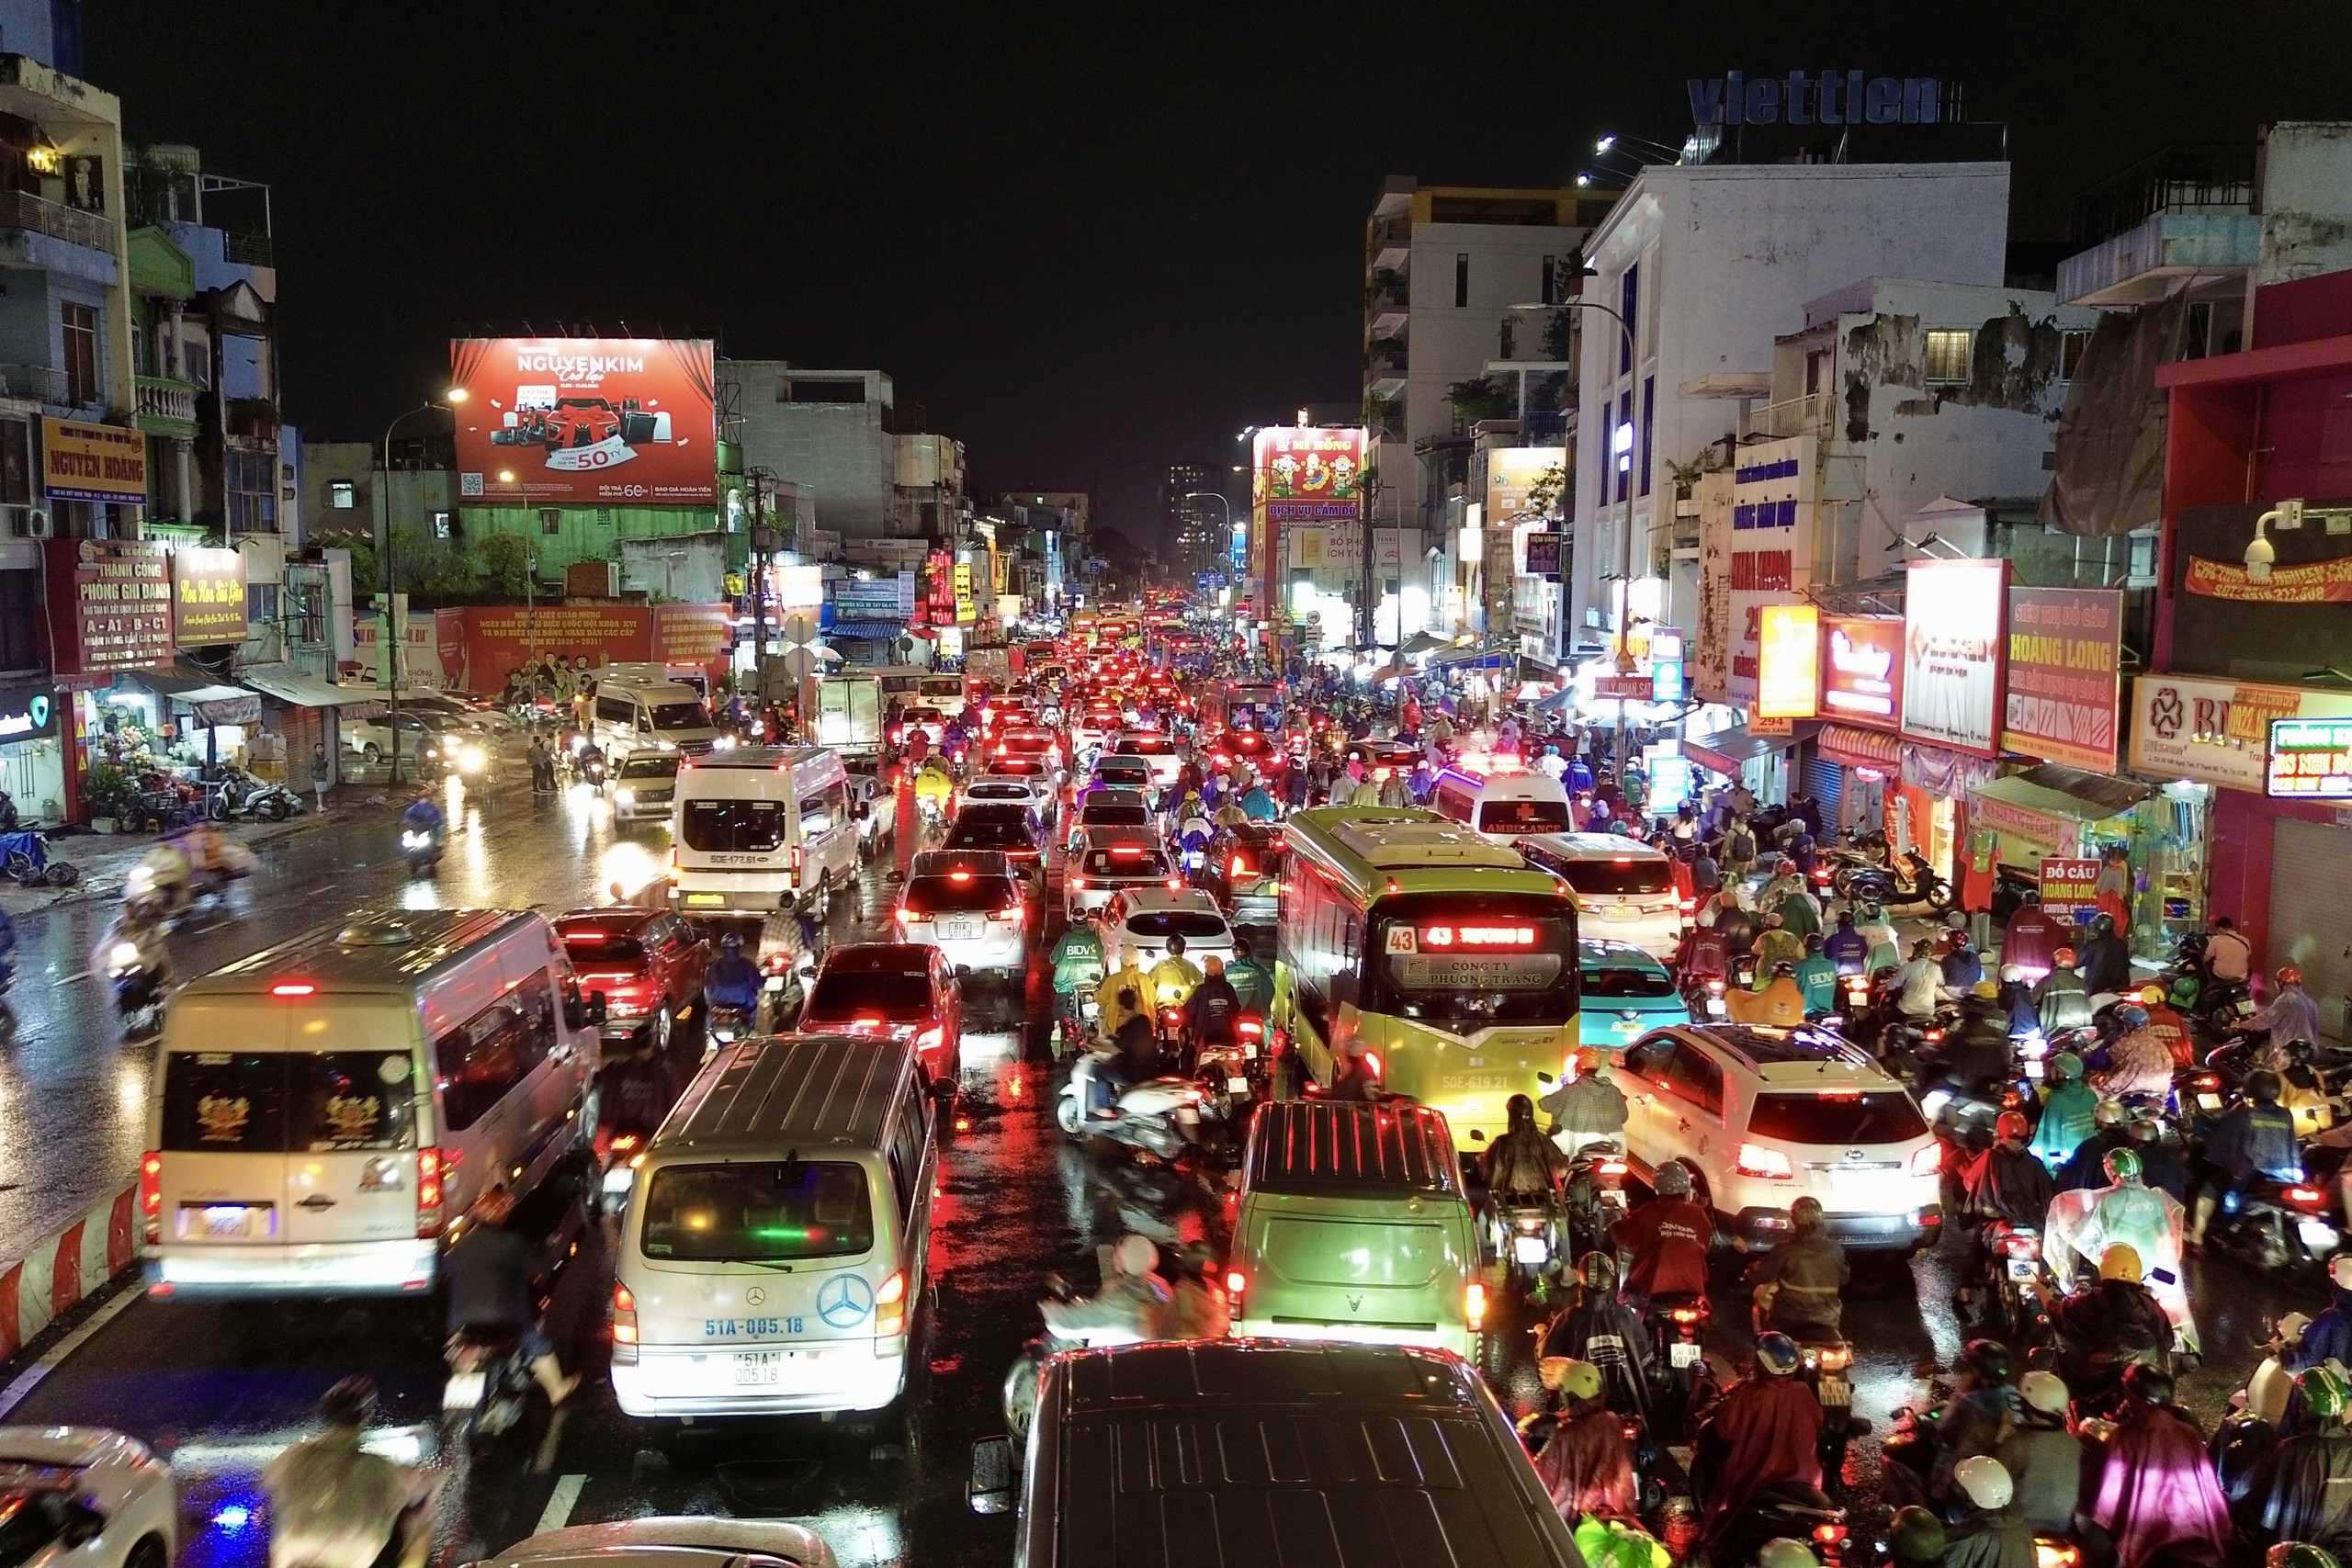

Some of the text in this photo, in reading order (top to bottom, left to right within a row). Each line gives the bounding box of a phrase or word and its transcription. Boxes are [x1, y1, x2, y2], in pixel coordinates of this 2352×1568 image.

[517, 355, 643, 373] NGUYENKIM
[578, 450, 608, 468] 50
[624, 484, 642, 497] 60
[1271, 505, 1295, 517] DỊCH
[1298, 505, 1311, 517] VỤ
[100, 560, 162, 577] THÀNH CÔNG
[80, 579, 171, 601] PHÒNG GHI DANH
[86, 616, 165, 633] A A1 B C1
[931, 608, 953, 625] TÔM
[2010, 630, 2062, 666] HOÀNG
[2065, 638, 2111, 672] LONG
[1618, 682, 1637, 695] QUAN
[1639, 679, 1652, 695] SÁT
[1758, 717, 1784, 726] 294
[1487, 823, 1562, 834] AMBULANCE
[2045, 862, 2096, 879] ĐỒ CÂU
[2042, 881, 2073, 898] HOÀNG
[1390, 931, 1413, 951] 43
[1427, 927, 1453, 944] 43
[1067, 945, 1091, 955] BIDV
[1451, 960, 1511, 971] CÔNG TY
[1227, 972, 1250, 980] GREEN
[1429, 973, 1542, 984] PHƯƠNG TRANG
[1442, 1076, 1509, 1089] 50E-619.21
[706, 1317, 803, 1337] 51A-005.18
[744, 1353, 769, 1367] 51A
